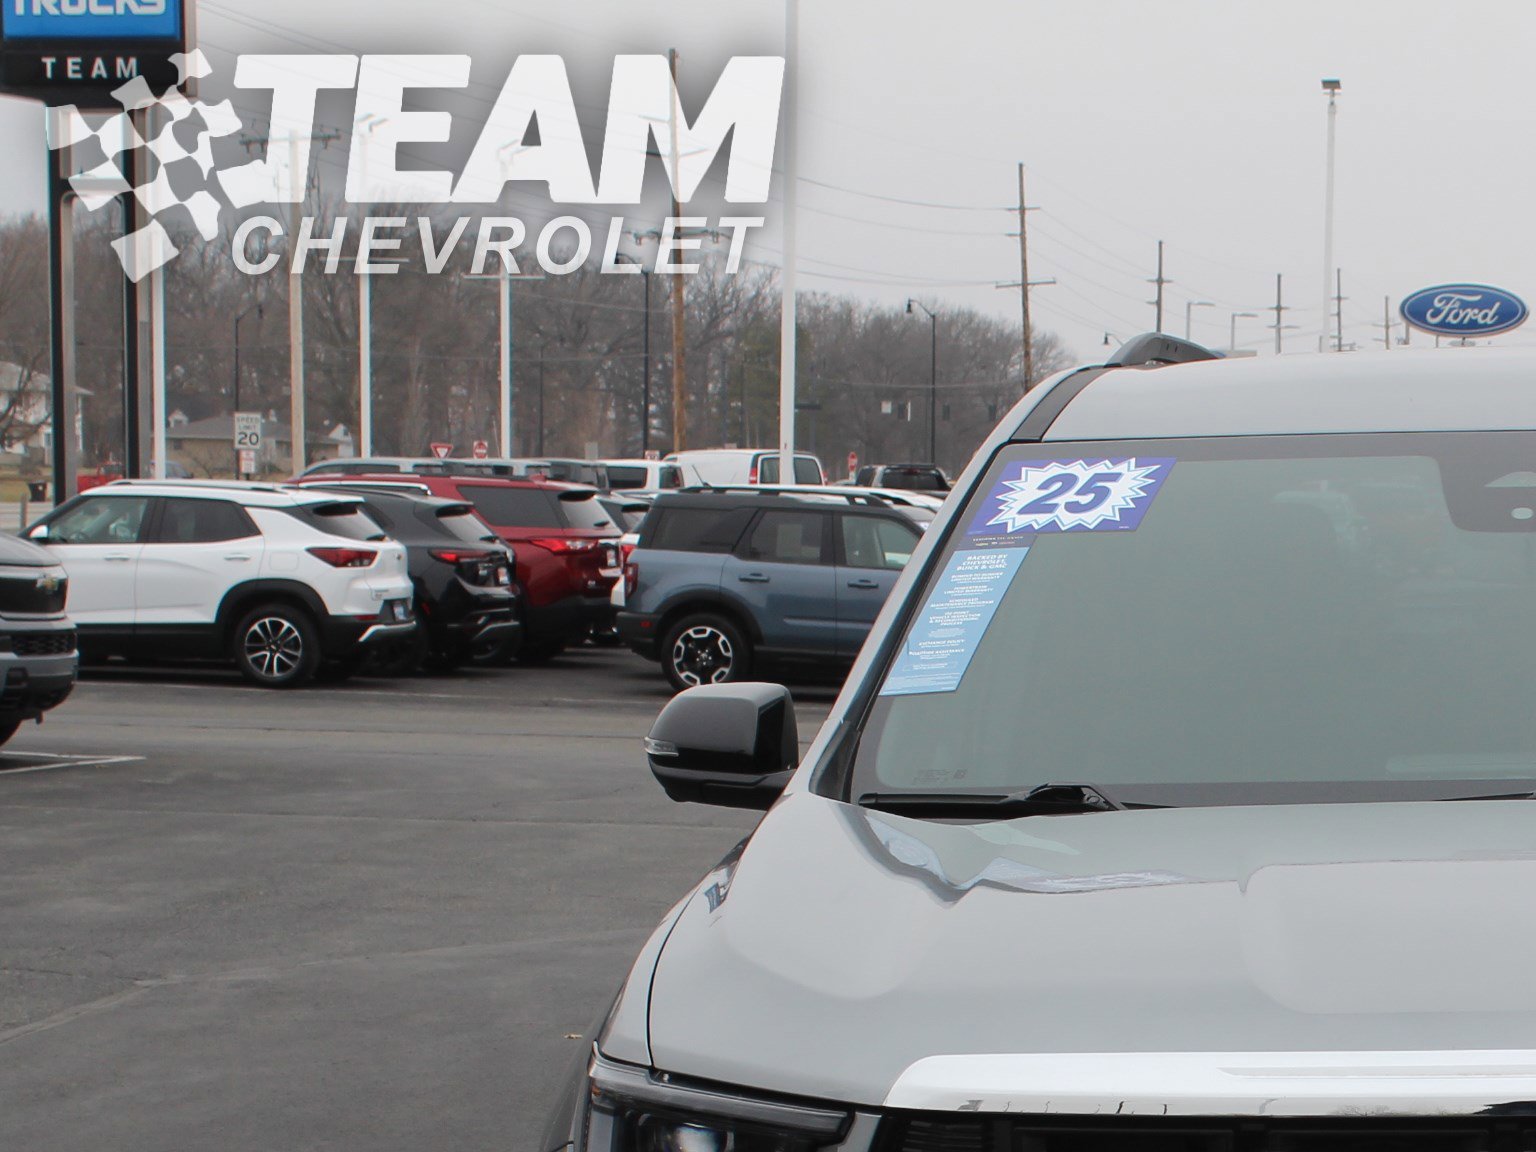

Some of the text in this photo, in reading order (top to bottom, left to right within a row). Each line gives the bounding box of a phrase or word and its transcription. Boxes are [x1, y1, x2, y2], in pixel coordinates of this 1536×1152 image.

[41, 57, 138, 79] TEAM
[1426, 293, 1500, 324] Ford
[238, 431, 259, 445] 20
[1017, 472, 1123, 514] 25
